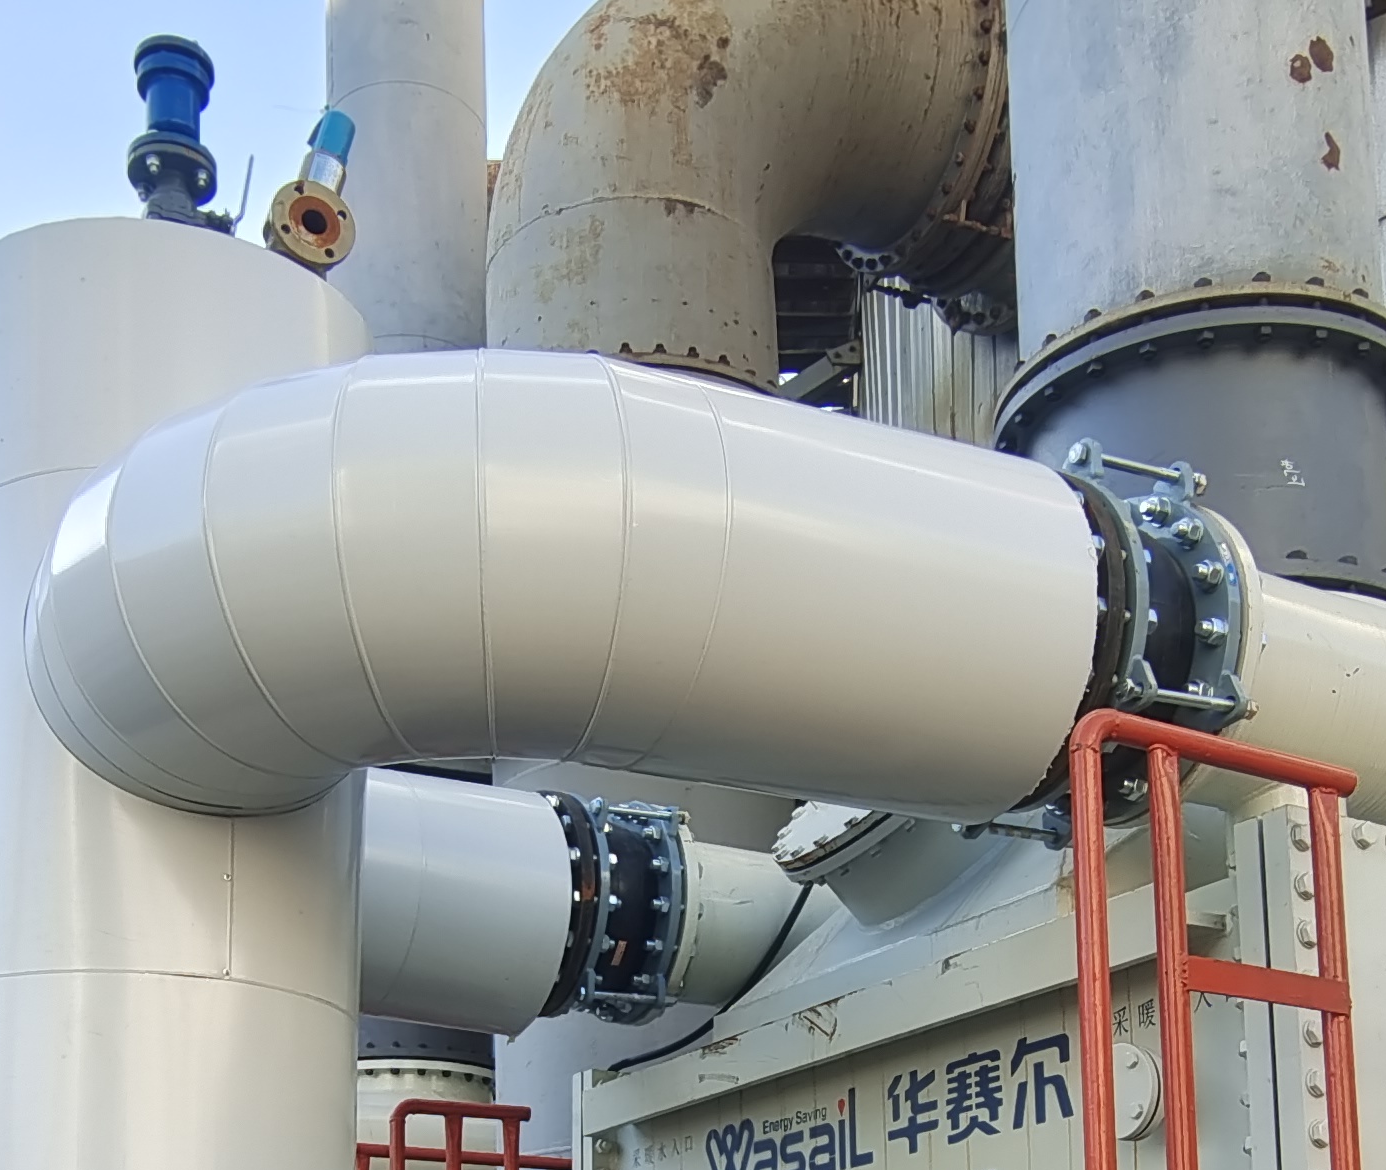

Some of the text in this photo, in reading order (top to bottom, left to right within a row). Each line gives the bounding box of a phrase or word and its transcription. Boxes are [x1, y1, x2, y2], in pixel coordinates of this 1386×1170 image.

[762, 1107, 827, 1135] Energy Saving
[887, 1033, 1074, 1154] 华赛尔
